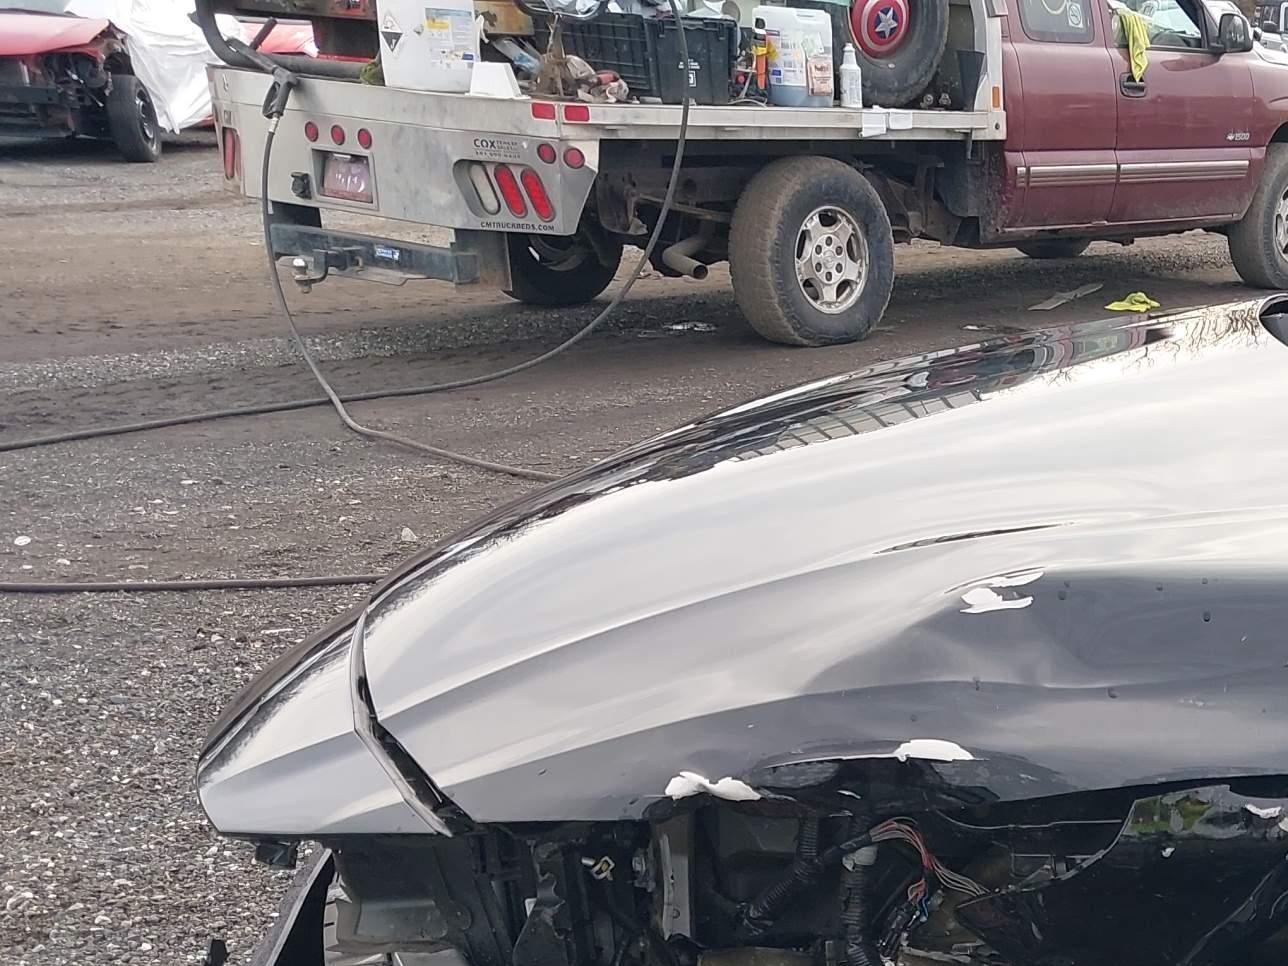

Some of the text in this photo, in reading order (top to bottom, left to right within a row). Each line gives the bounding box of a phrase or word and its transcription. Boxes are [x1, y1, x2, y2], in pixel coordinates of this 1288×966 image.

[1235, 132, 1250, 141] 1500
[473, 138, 497, 149] COX
[480, 221, 555, 232] CMTRUCKBEDS.COM
